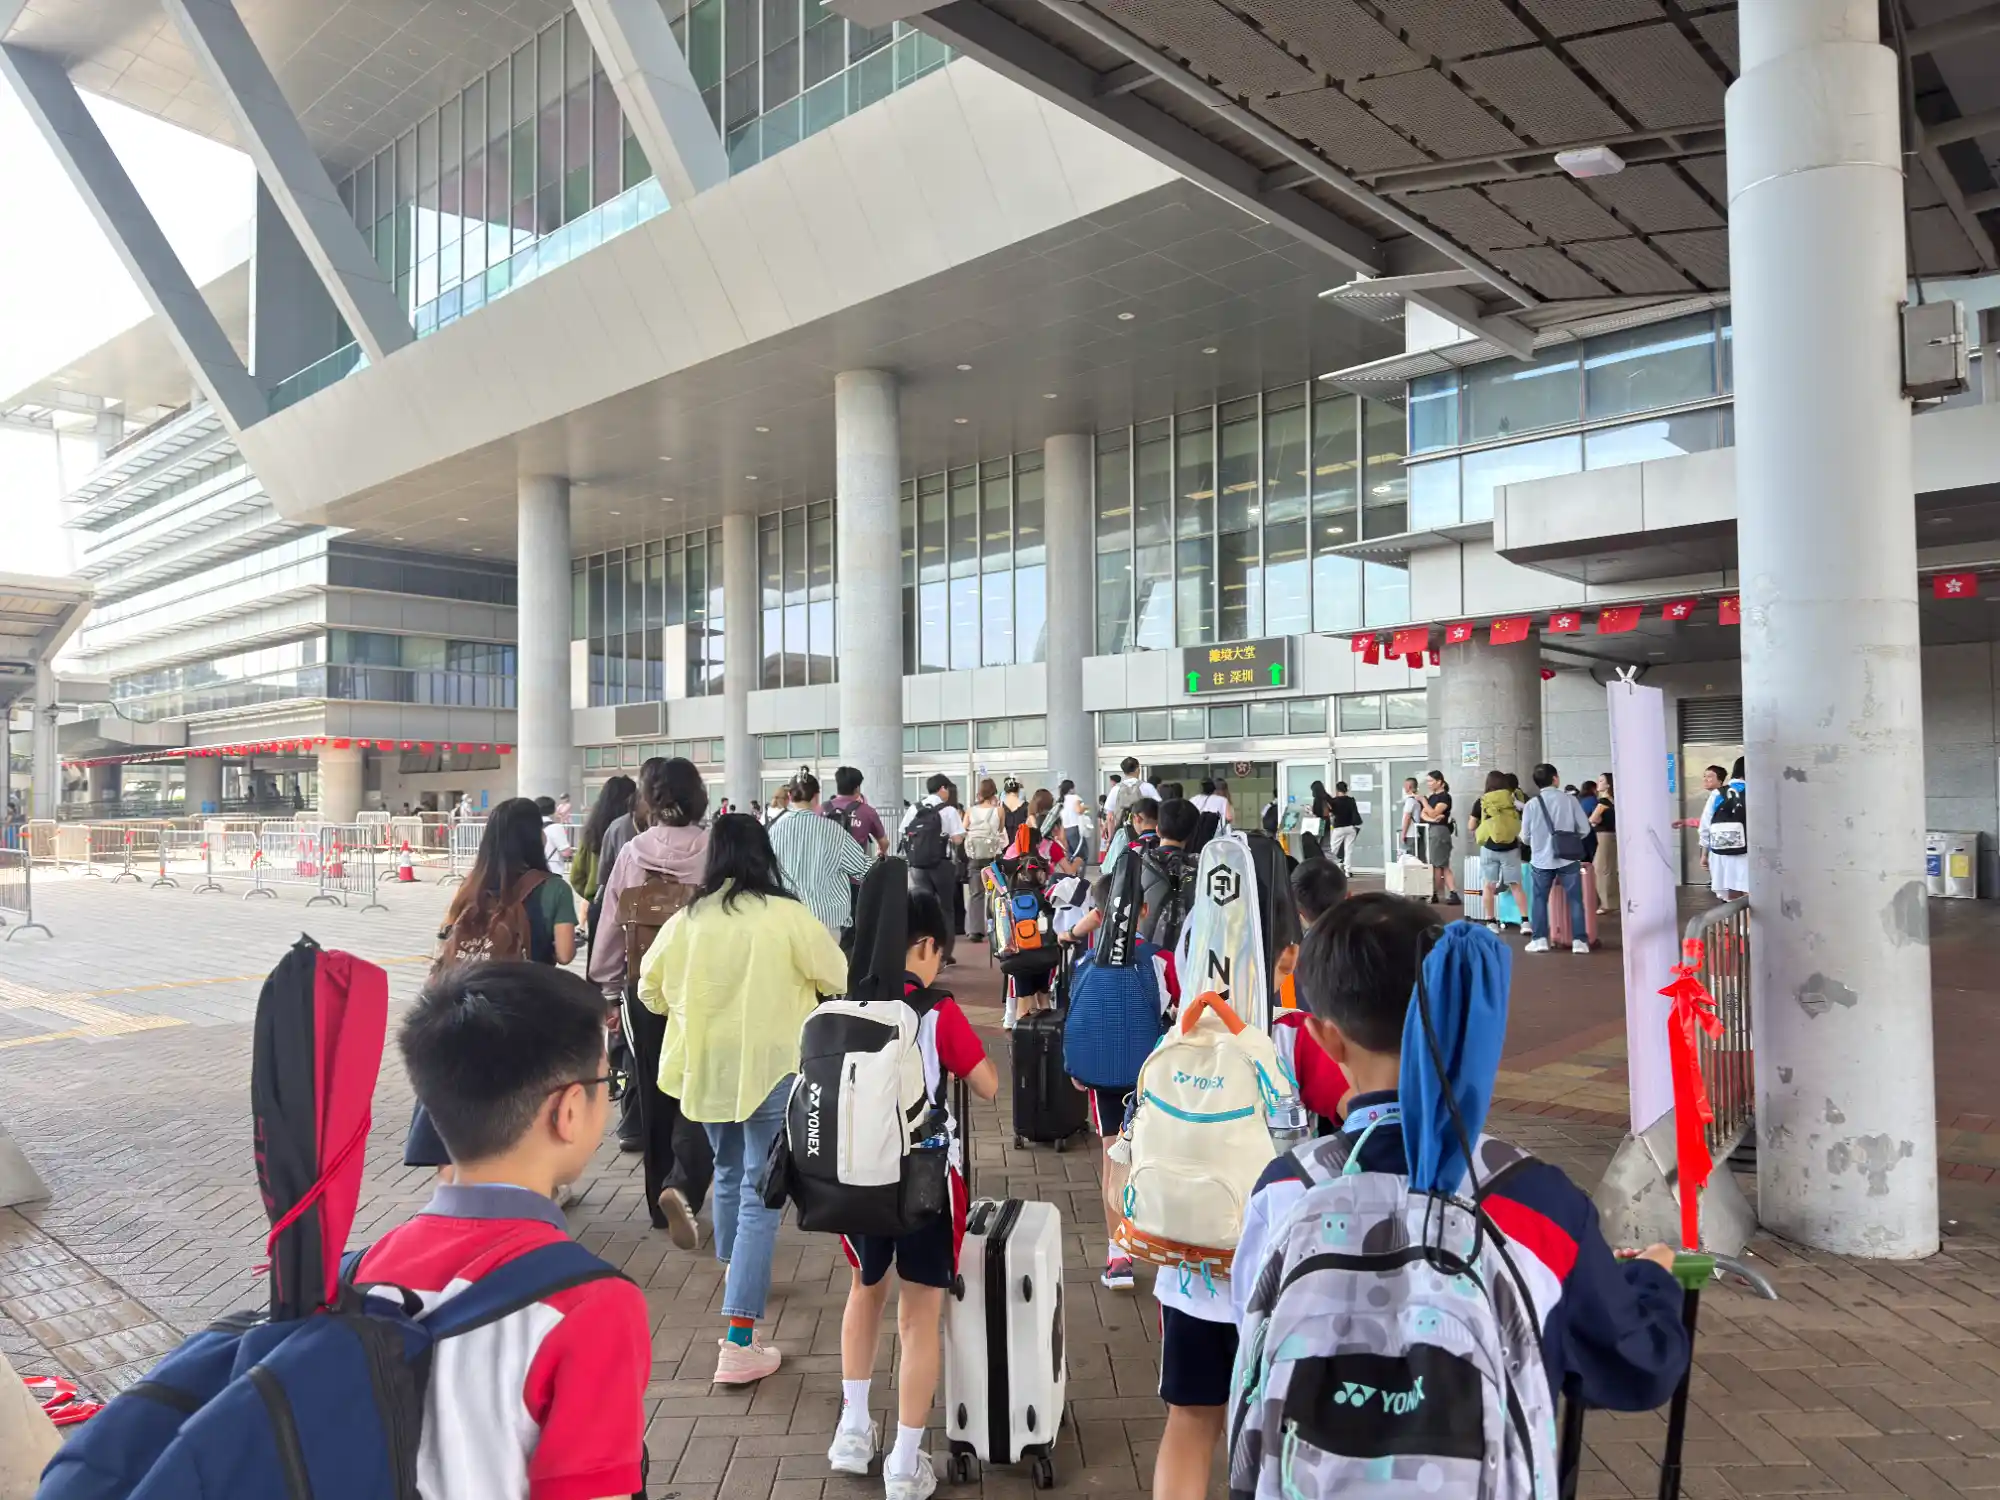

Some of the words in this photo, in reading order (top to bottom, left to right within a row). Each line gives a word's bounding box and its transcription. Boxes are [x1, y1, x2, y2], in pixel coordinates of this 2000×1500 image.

[1212, 672, 1225, 685] 往
[1229, 669, 1254, 684] 深圳
[807, 1110, 821, 1158] YONEX
